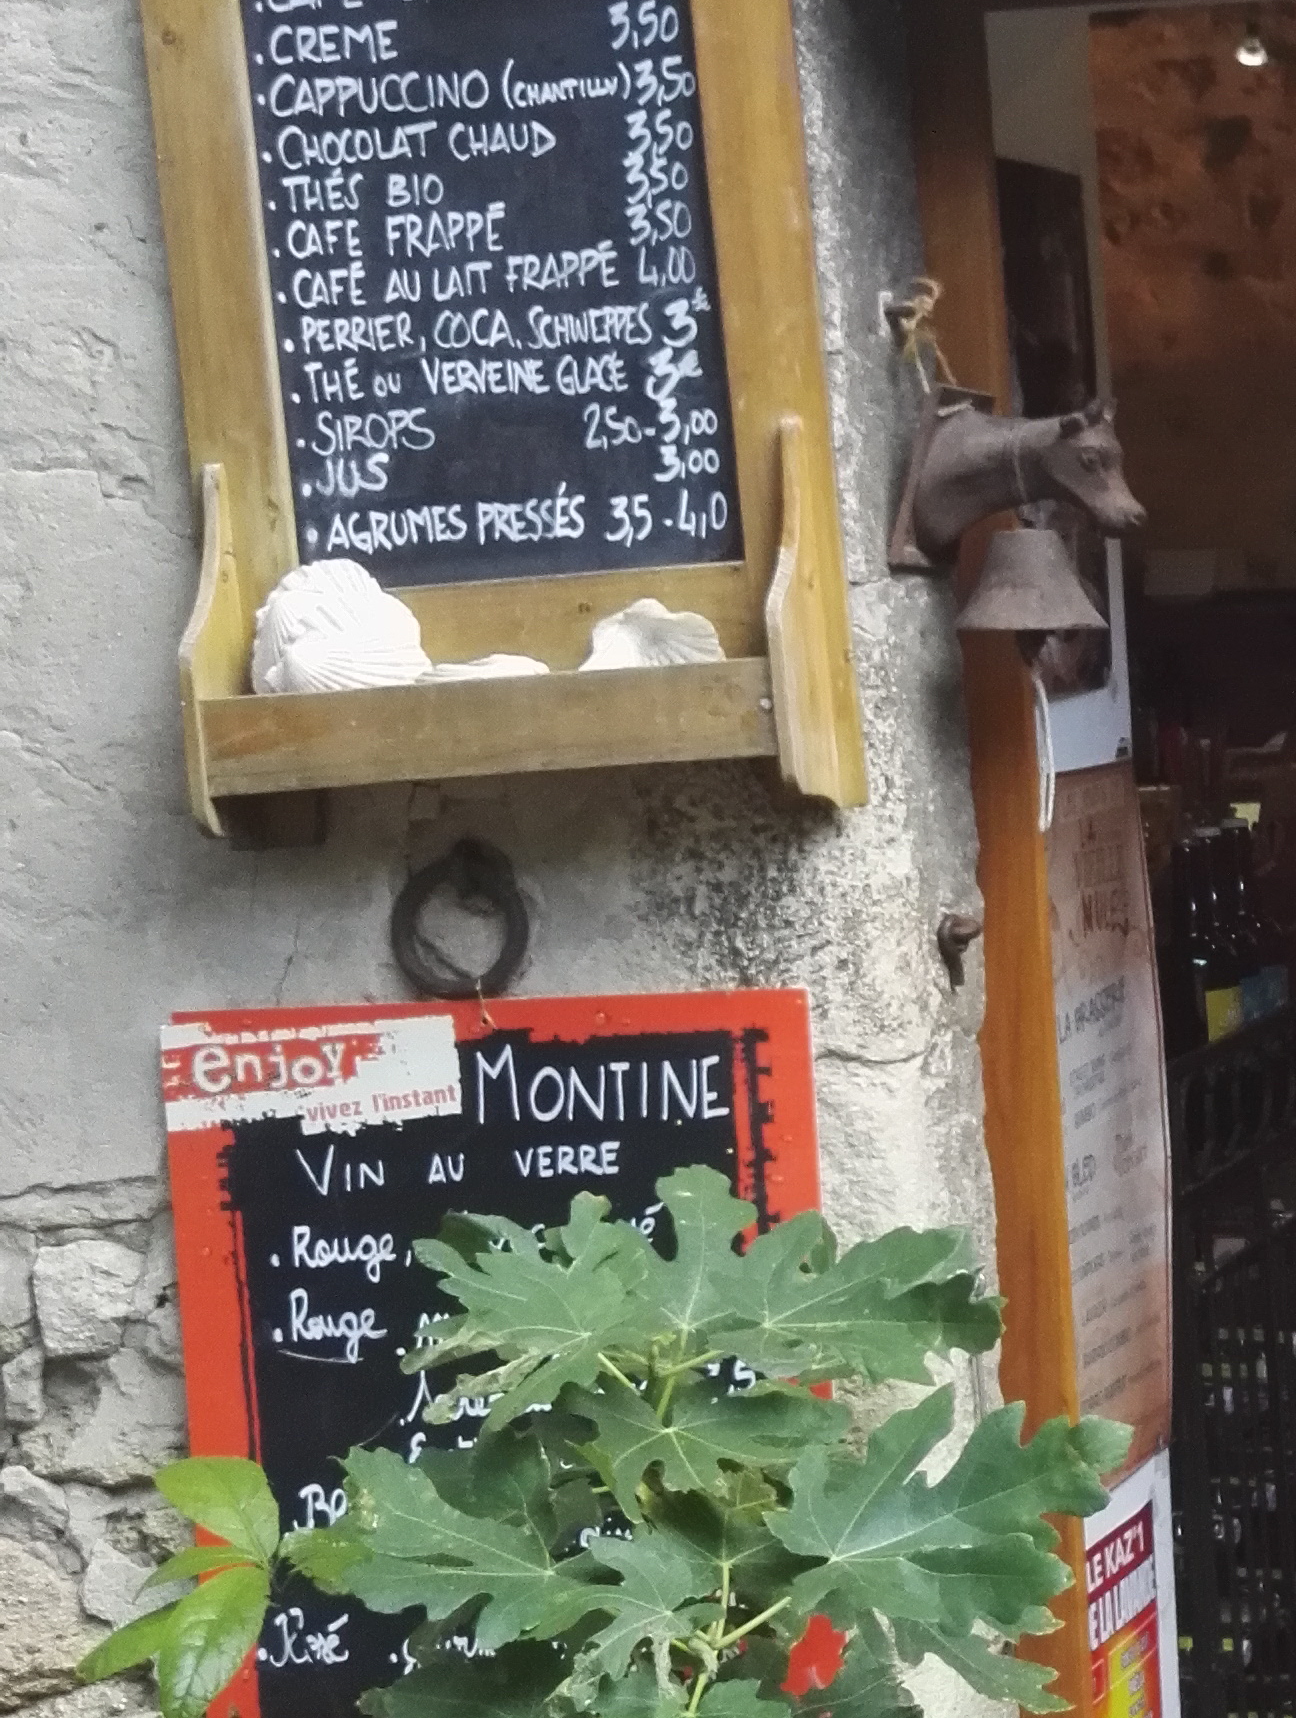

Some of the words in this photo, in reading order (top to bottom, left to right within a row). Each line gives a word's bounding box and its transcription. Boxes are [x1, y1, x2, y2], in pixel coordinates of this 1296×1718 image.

[269, 19, 399, 66] CREME
[269, 68, 490, 118] CAPPUCCINO
[633, 54, 697, 108] 3,50
[276, 120, 438, 171] CHOCOLAT
[447, 119, 558, 162] CHAUD
[281, 166, 365, 214] THÉS
[385, 172, 445, 207] BIO
[384, 200, 506, 259] FRAPPÉ
[624, 198, 693, 247] 3,50
[292, 260, 368, 309] CAFÉ
[384, 267, 421, 303] AU
[432, 260, 494, 303] LAIT
[505, 238, 620, 294] FRAPPÉ
[637, 244, 697, 288] 4,00
[527, 301, 653, 350] SCHWEPPES
[303, 356, 366, 404] THÉ
[419, 356, 551, 395] VERVEINE
[311, 406, 436, 457] SIROPS
[315, 452, 391, 496] JUS
[652, 443, 721, 483] 3,00
[326, 502, 469, 555] AGRUMES
[476, 480, 586, 547] PRESSÉS
[190, 1042, 345, 1096] enjoy
[474, 1043, 731, 1125] MONTINE
[305, 1098, 364, 1123] vivez
[371, 1083, 458, 1115] l'instant
[288, 1288, 388, 1361] Rouge
